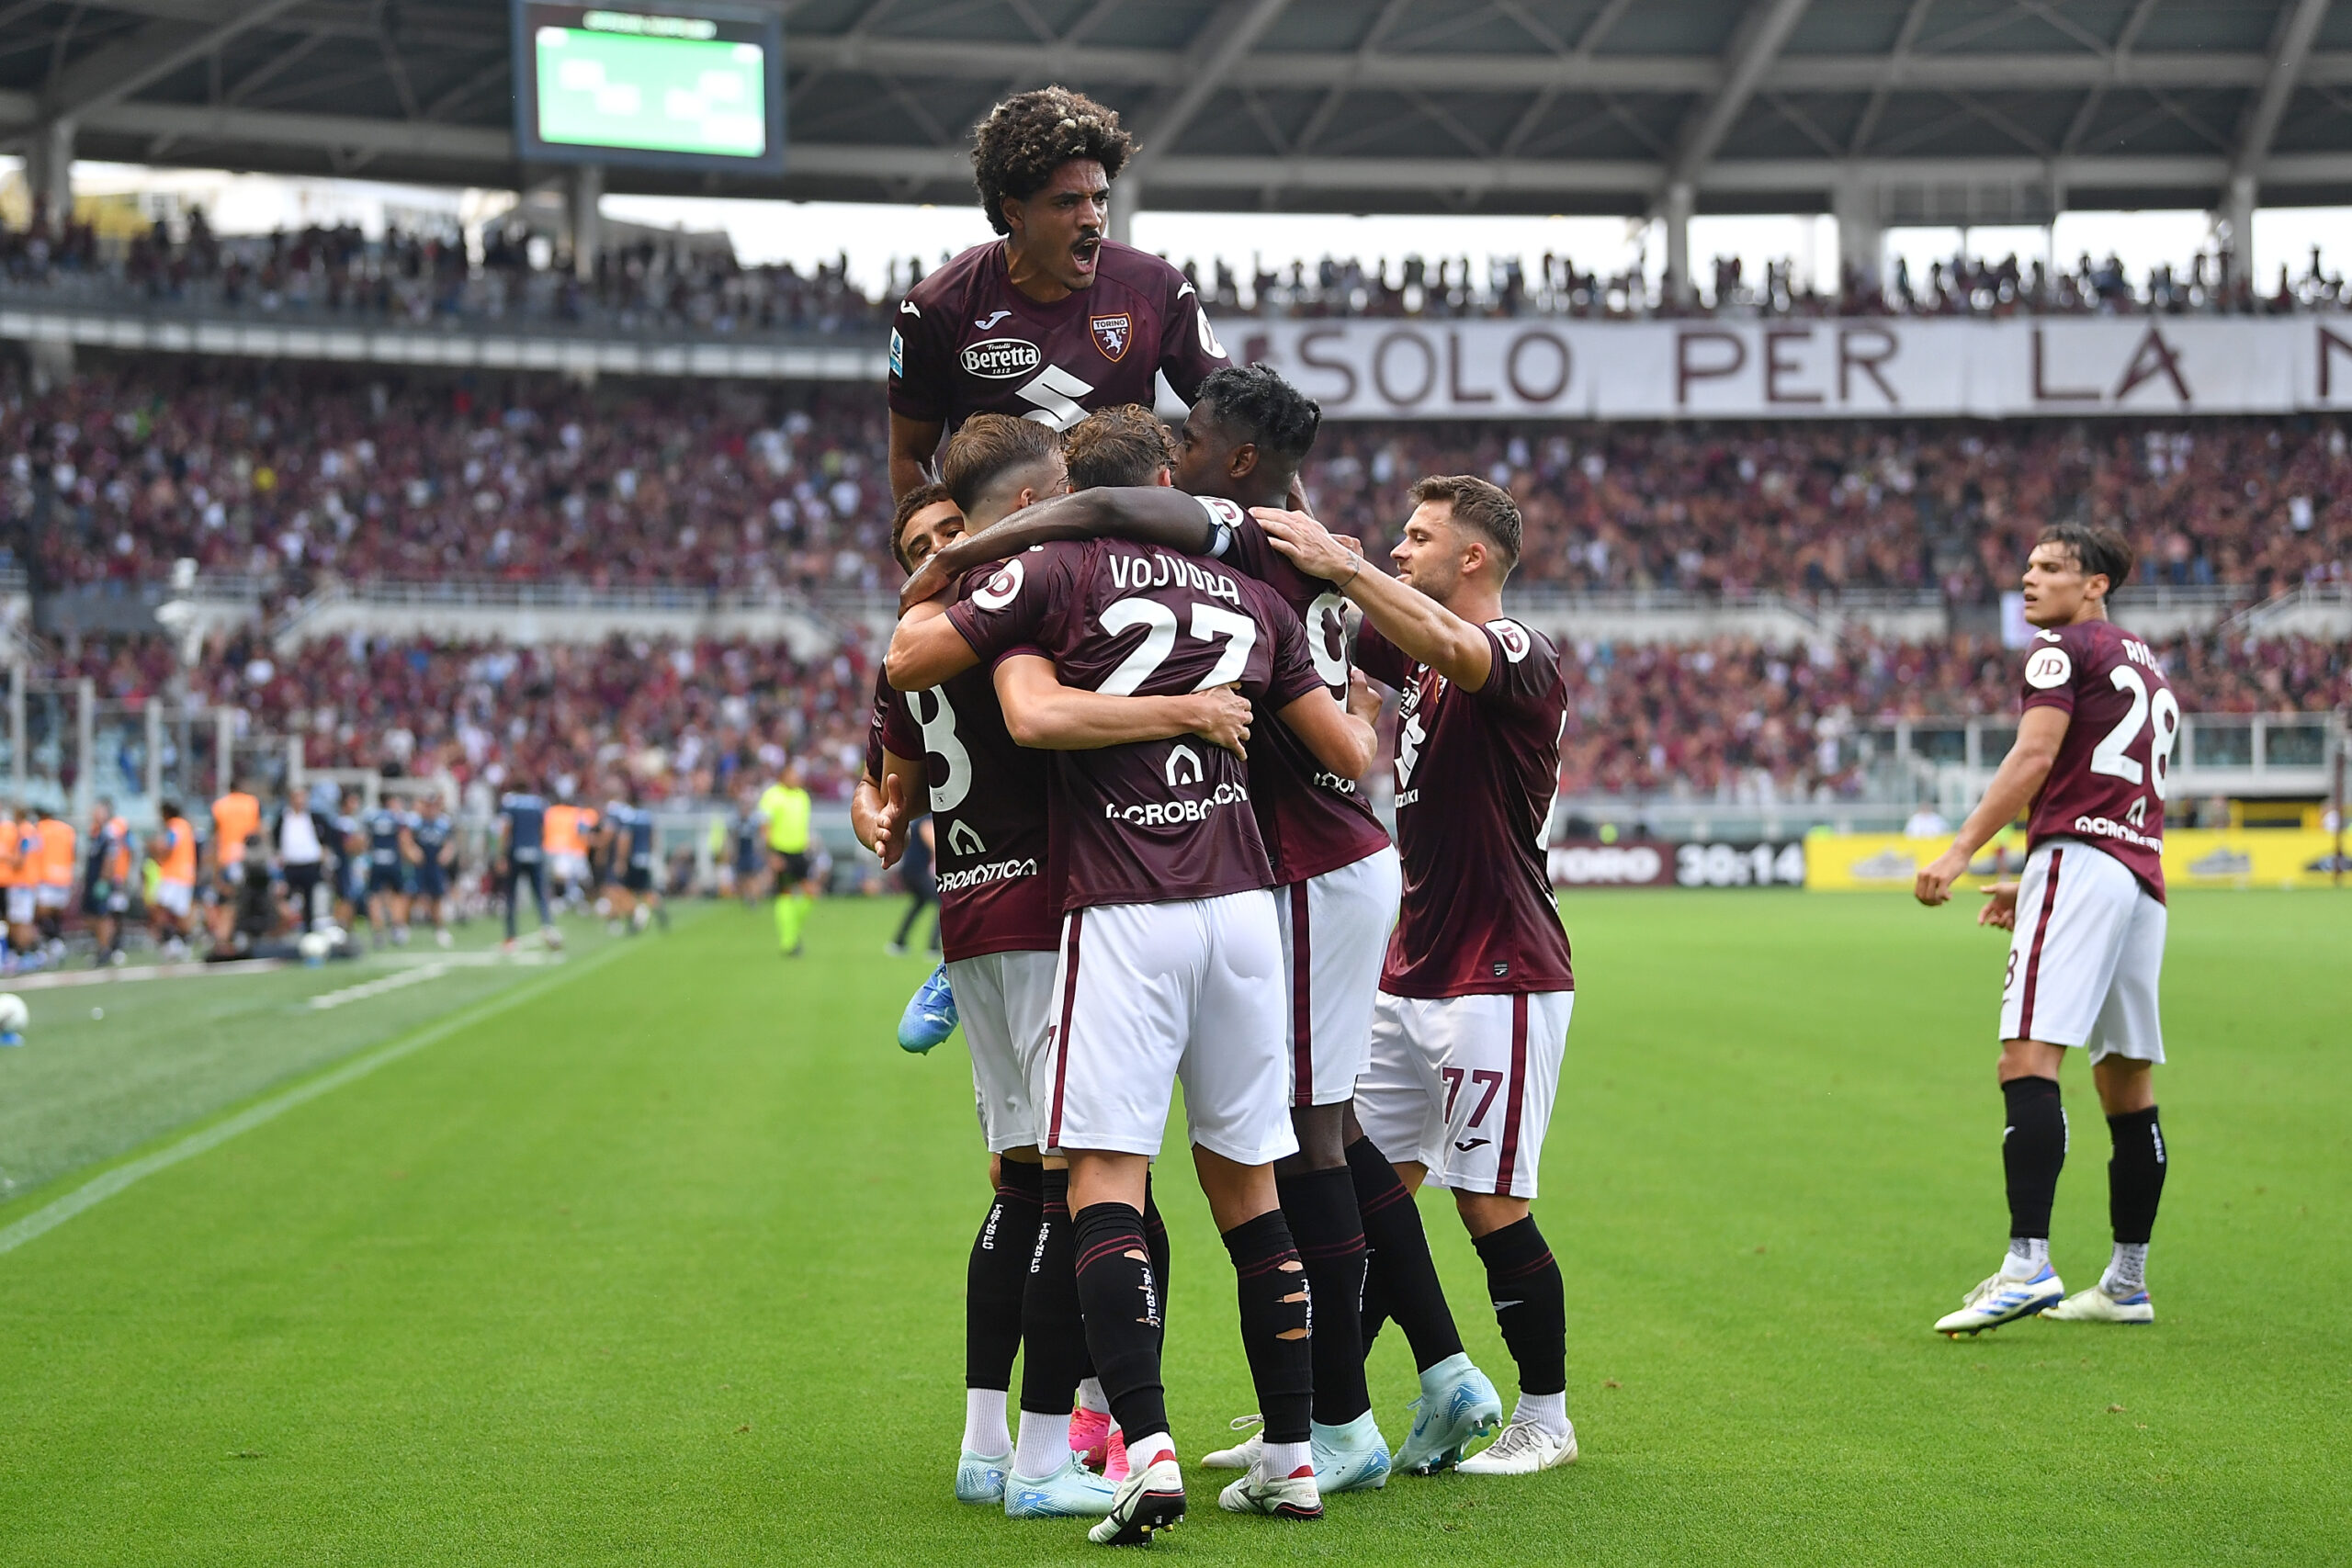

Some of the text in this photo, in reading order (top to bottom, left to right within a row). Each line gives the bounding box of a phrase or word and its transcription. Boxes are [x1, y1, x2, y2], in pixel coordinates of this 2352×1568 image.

[1095, 320, 1125, 328] TORINO
[965, 346, 1037, 370] Beretta
[1296, 327, 1574, 408] SOLO
[1675, 323, 1900, 407] PER
[2031, 323, 2192, 404] LA
[1109, 554, 1240, 605] VOJVODA
[1097, 597, 1258, 697] 27
[2033, 659, 2064, 678] JD
[2090, 664, 2180, 802] 28
[1442, 1068, 1504, 1129] 77
